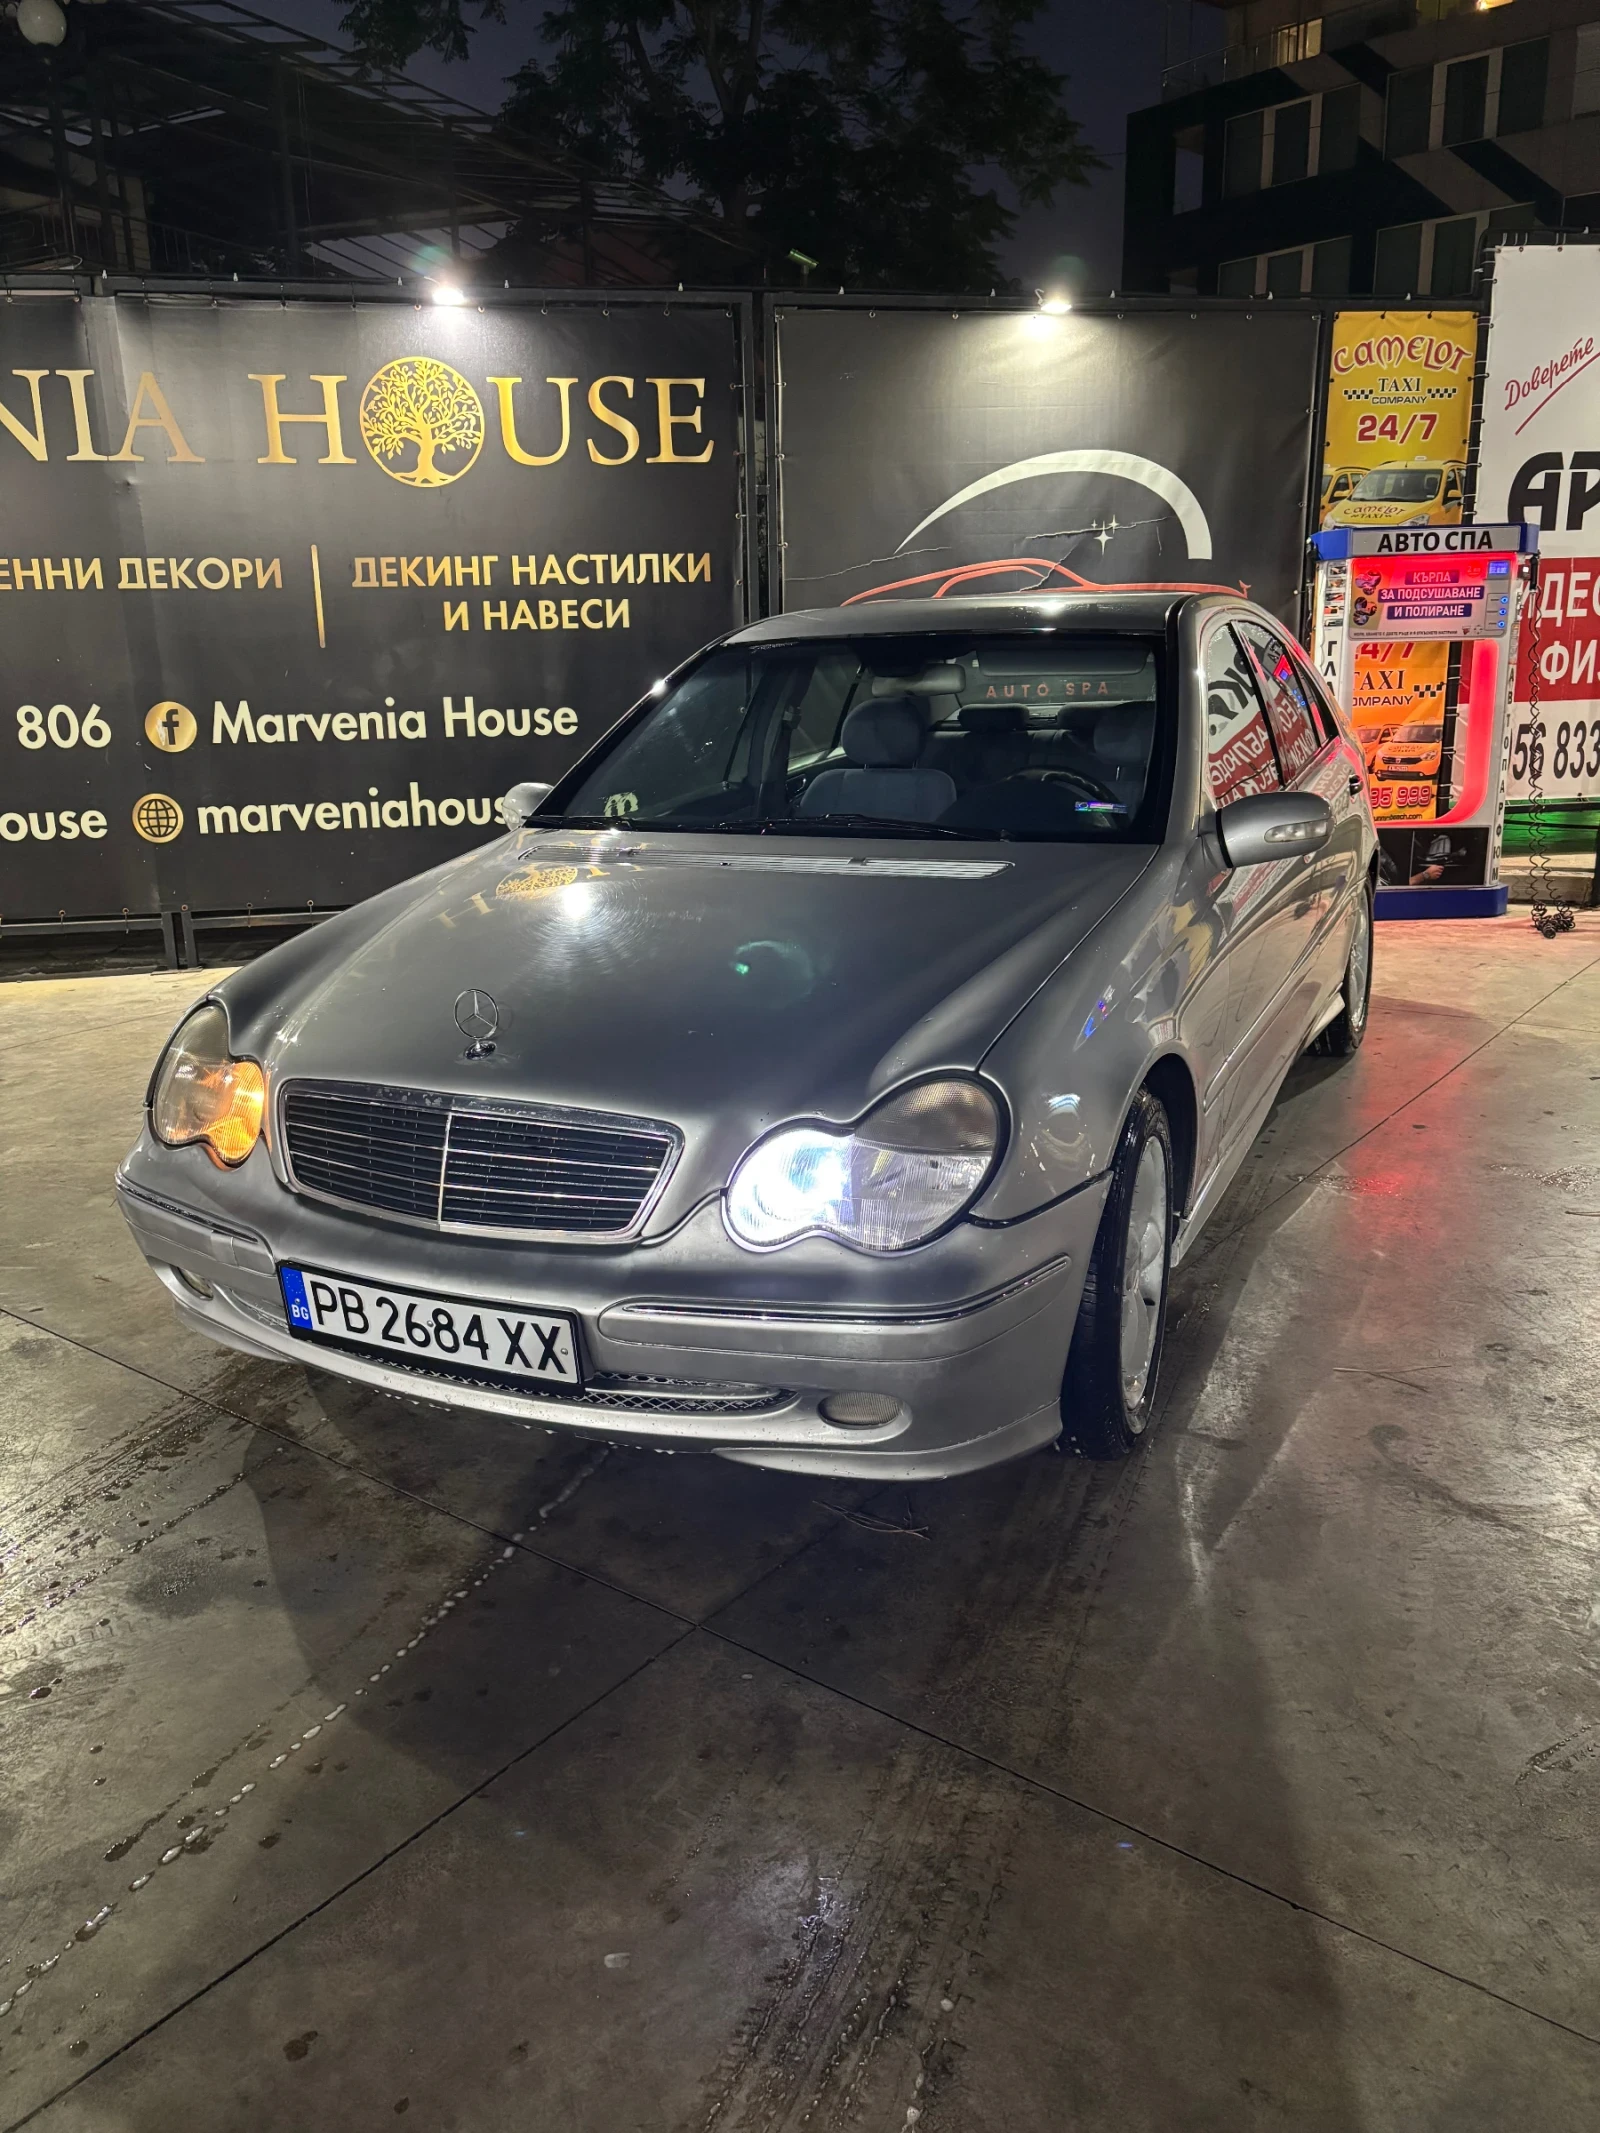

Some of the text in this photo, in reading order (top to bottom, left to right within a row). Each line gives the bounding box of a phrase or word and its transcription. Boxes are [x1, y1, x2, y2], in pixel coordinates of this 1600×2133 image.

[1378, 376, 1422, 392] TAXI
[1371, 396, 1427, 405] COMPANY
[1357, 413, 1438, 444] 24/7
[1377, 530, 1493, 552] АВТО СПА
[117, 557, 283, 592] ДЕКОРИ
[351, 552, 712, 588] ДЕКИНГ НАСТИЛКИ
[1412, 571, 1452, 583] КЪРПА
[1380, 587, 1481, 601] ЗА ПОДСУШАВАНЕ
[443, 598, 630, 631] И НАВЕСИ
[1393, 605, 1465, 617] И ПОЛИРАНЕ
[1540, 639, 1600, 685] ФИ
[985, 681, 1109, 699] AUTO SPA
[16, 703, 112, 750] 806
[211, 697, 427, 746] Marvenia
[442, 696, 578, 738] House
[1396, 785, 1432, 808] 999
[0, 810, 108, 842] ouse
[291, 1303, 310, 1321] BG
[310, 1280, 568, 1374] PB 2684 XX
